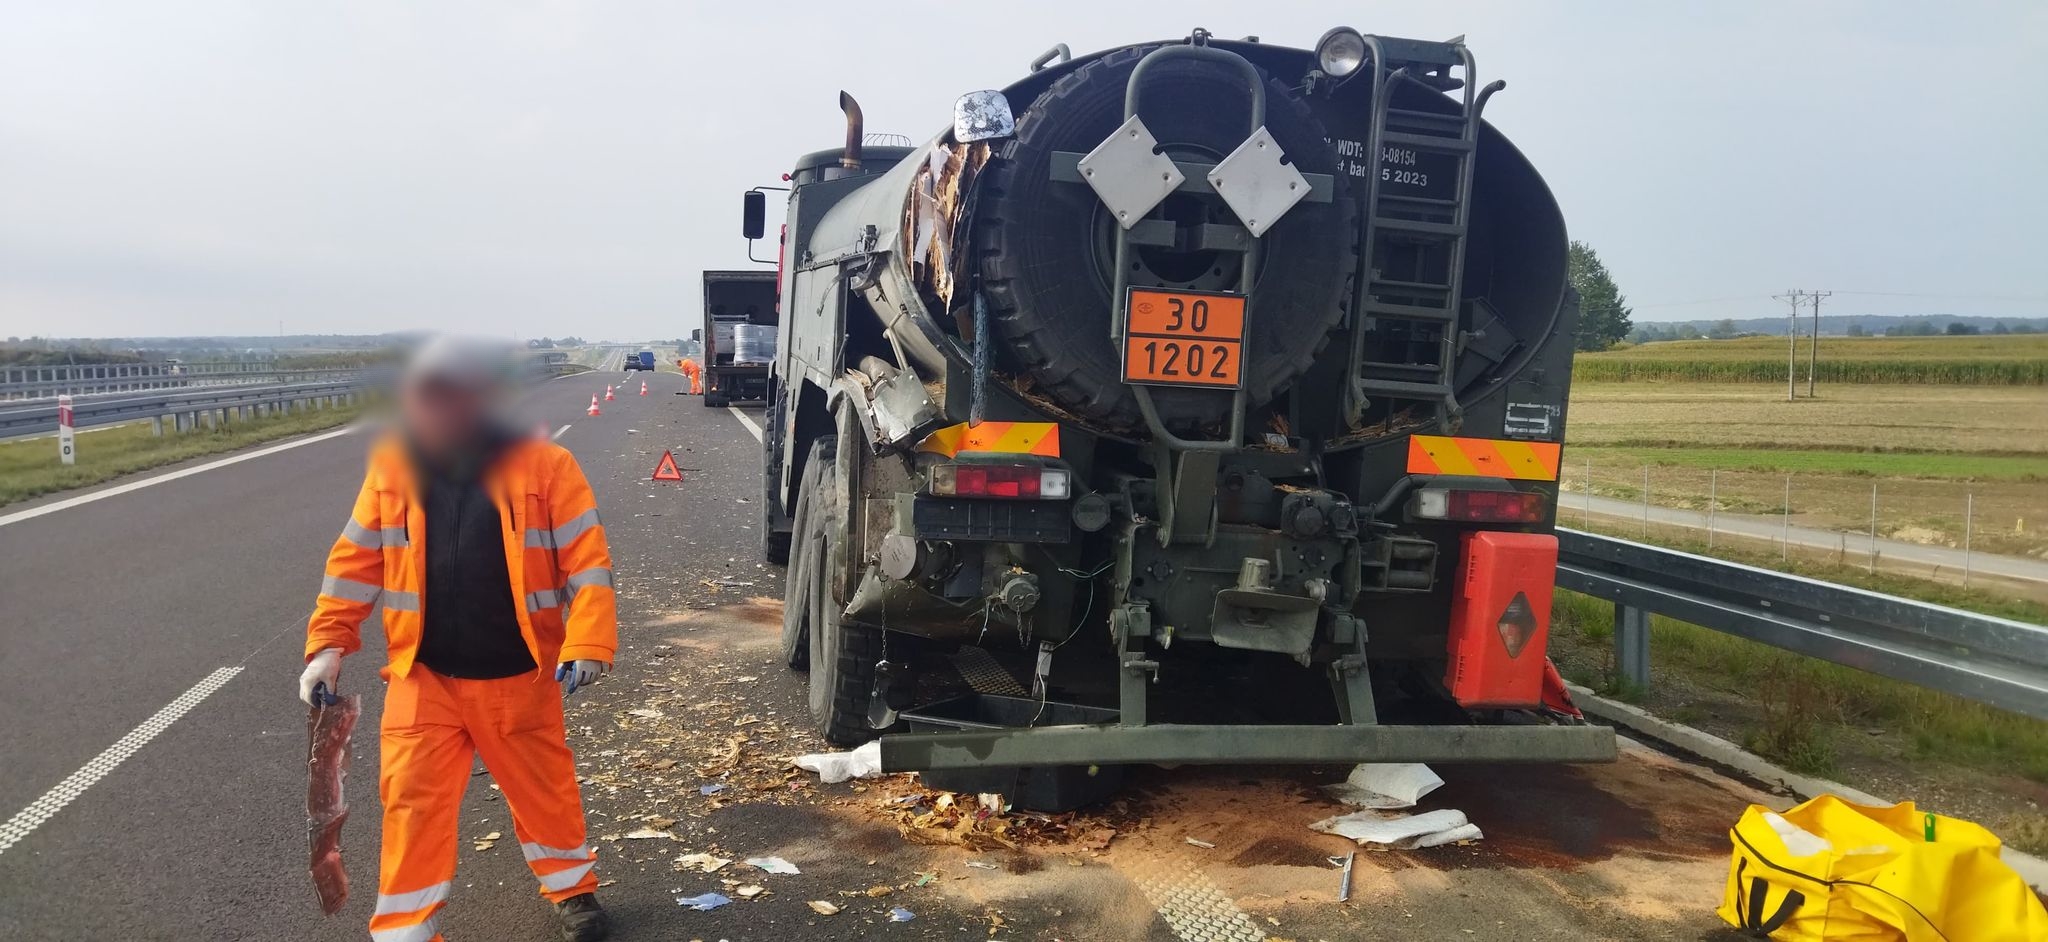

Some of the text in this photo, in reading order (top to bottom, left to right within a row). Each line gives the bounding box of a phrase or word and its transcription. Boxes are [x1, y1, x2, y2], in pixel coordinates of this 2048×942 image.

[1337, 139, 1363, 158] WDT:
[1394, 170, 1428, 187] 2023
[1166, 298, 1209, 333] 30
[1144, 341, 1229, 378] 1202
